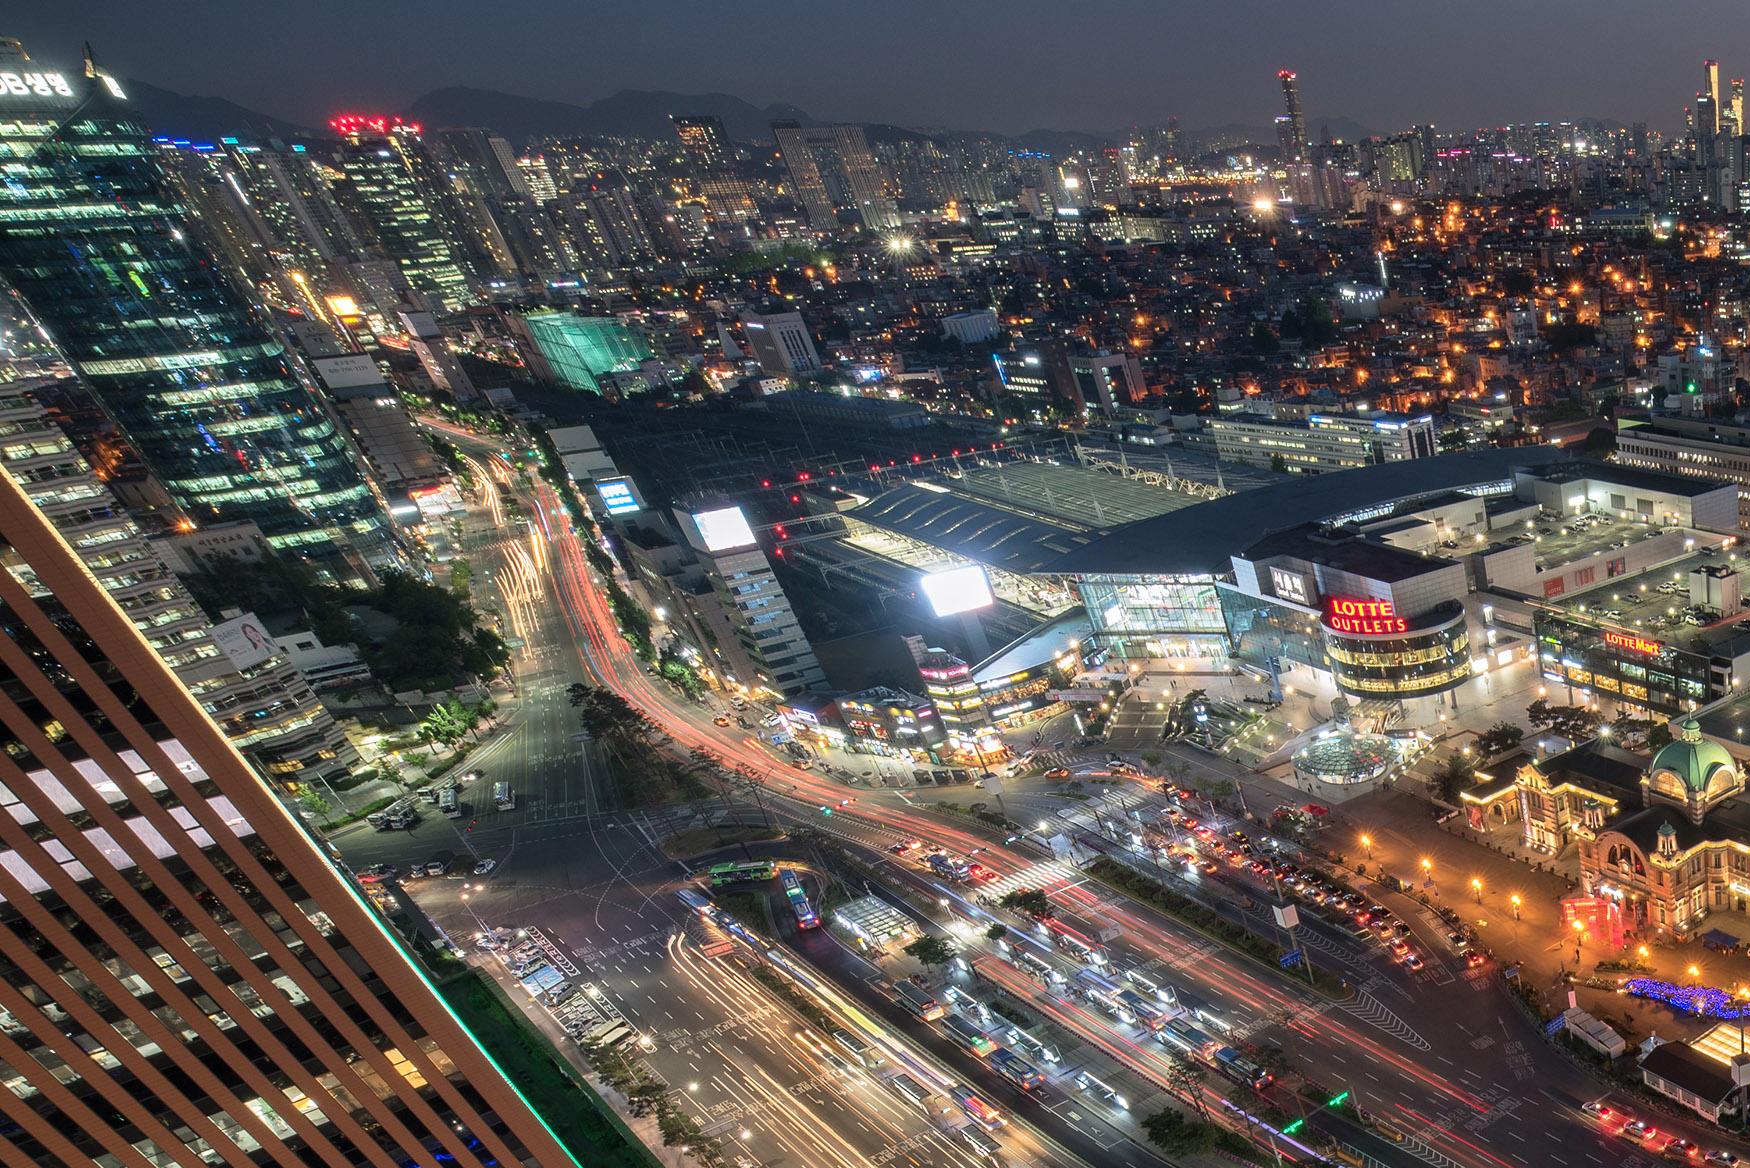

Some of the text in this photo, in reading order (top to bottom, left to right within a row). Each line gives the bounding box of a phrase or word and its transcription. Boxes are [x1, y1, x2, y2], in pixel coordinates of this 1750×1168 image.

[1332, 599, 1394, 617] LOTTE
[1331, 616, 1406, 633] OUTLETS
[1605, 632, 1660, 656] LOTTE Mart
